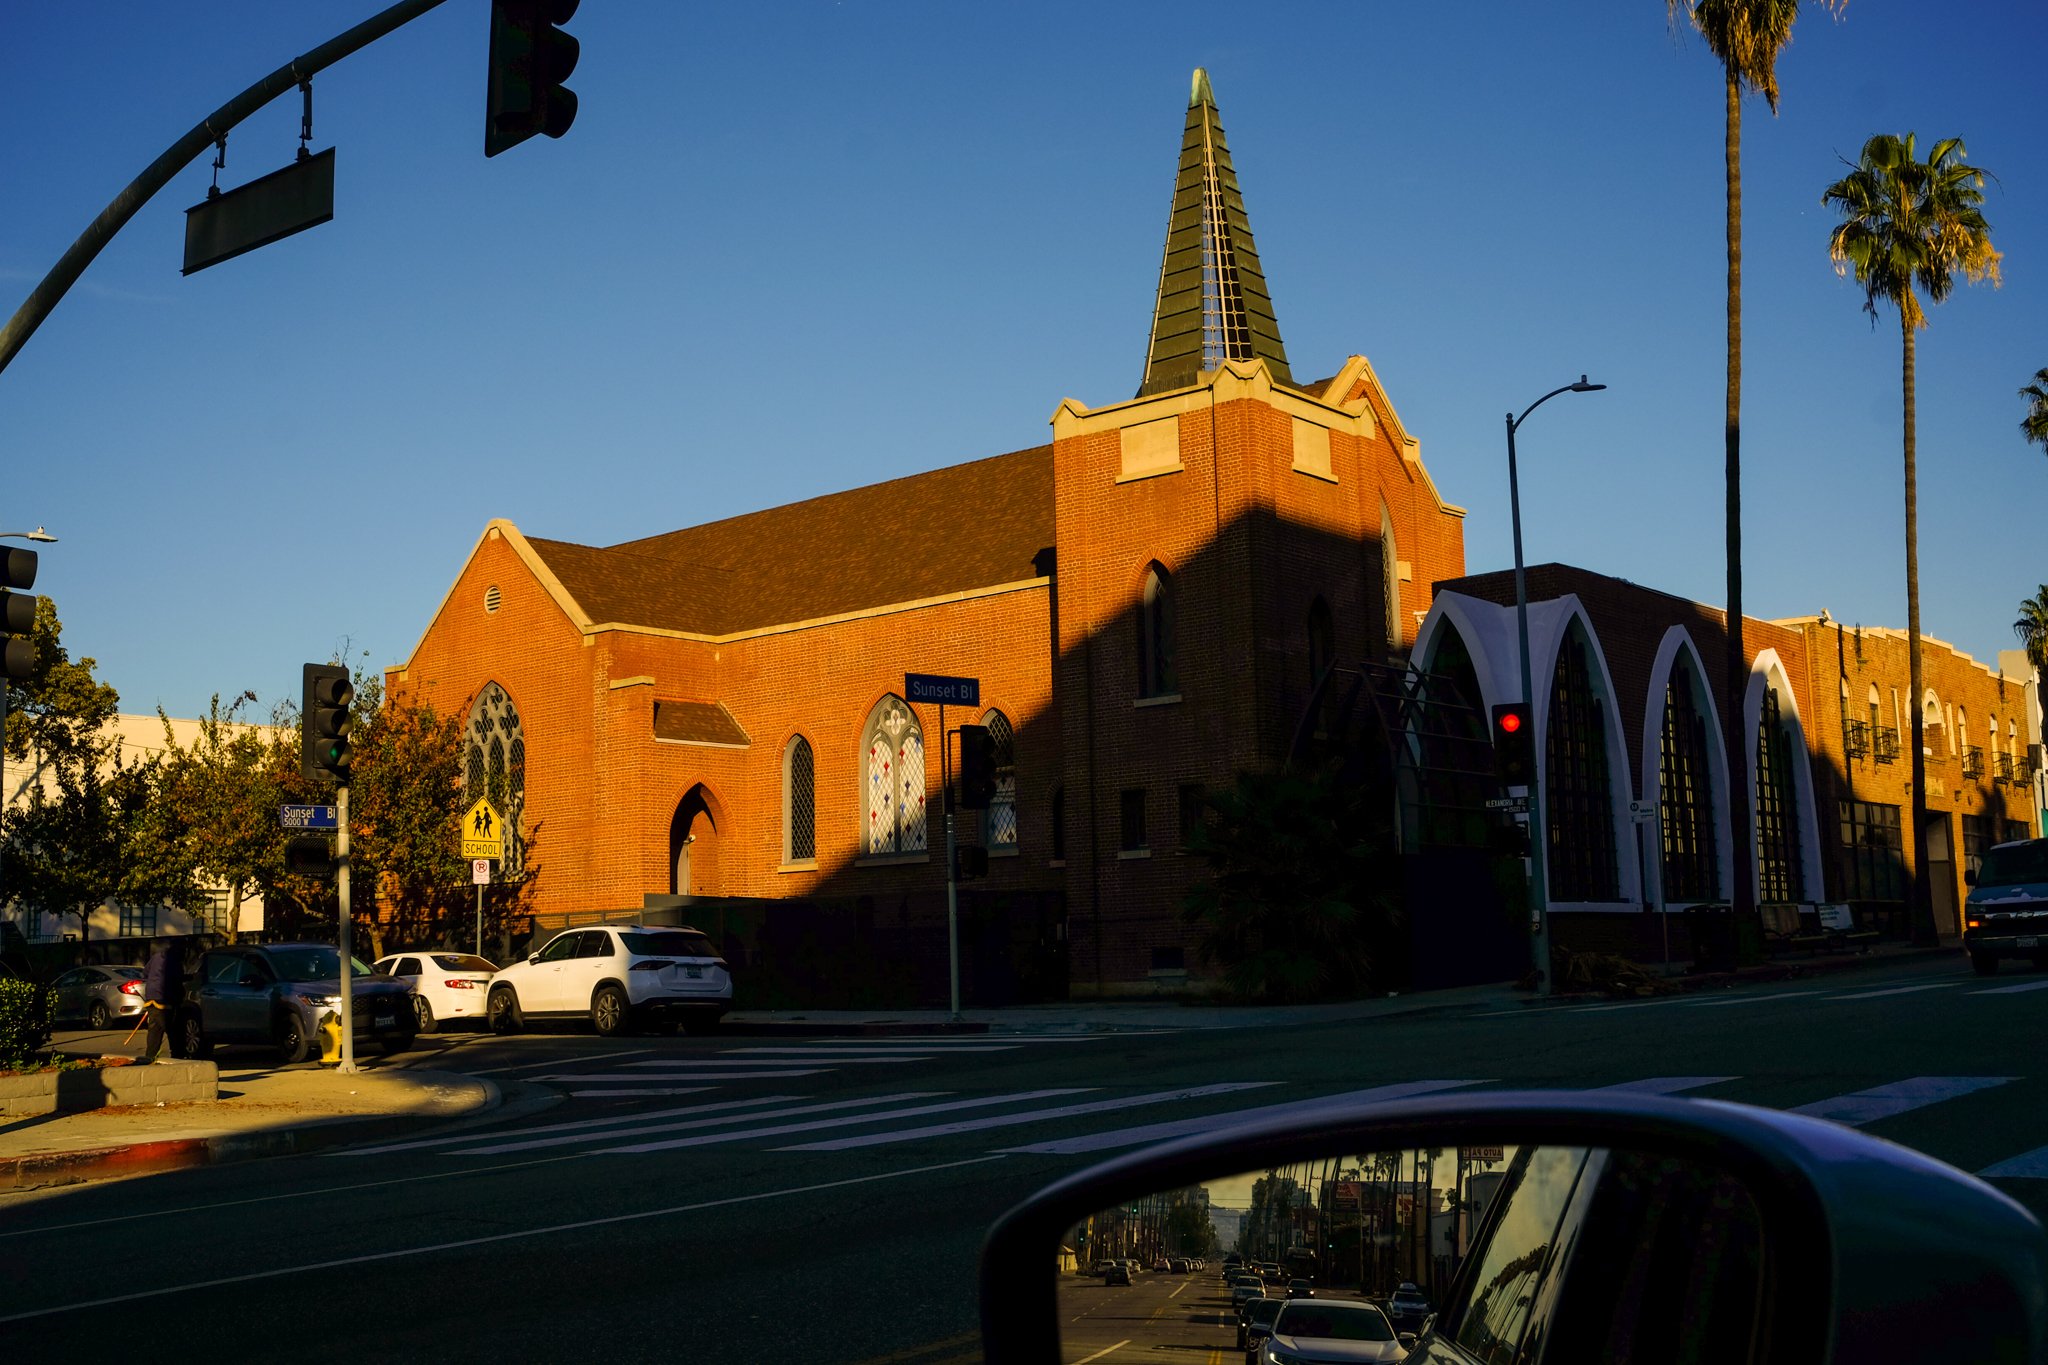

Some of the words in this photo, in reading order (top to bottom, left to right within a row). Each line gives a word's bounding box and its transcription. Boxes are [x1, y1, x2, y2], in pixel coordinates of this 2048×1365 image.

[913, 681, 956, 699] Sunset
[960, 684, 973, 700] Bl
[1485, 798, 1514, 808] ALEXANDRIA
[284, 806, 315, 819] Sunset
[326, 807, 336, 819] Bl
[284, 818, 301, 826] 5000
[465, 843, 498, 855] SCHOOL
